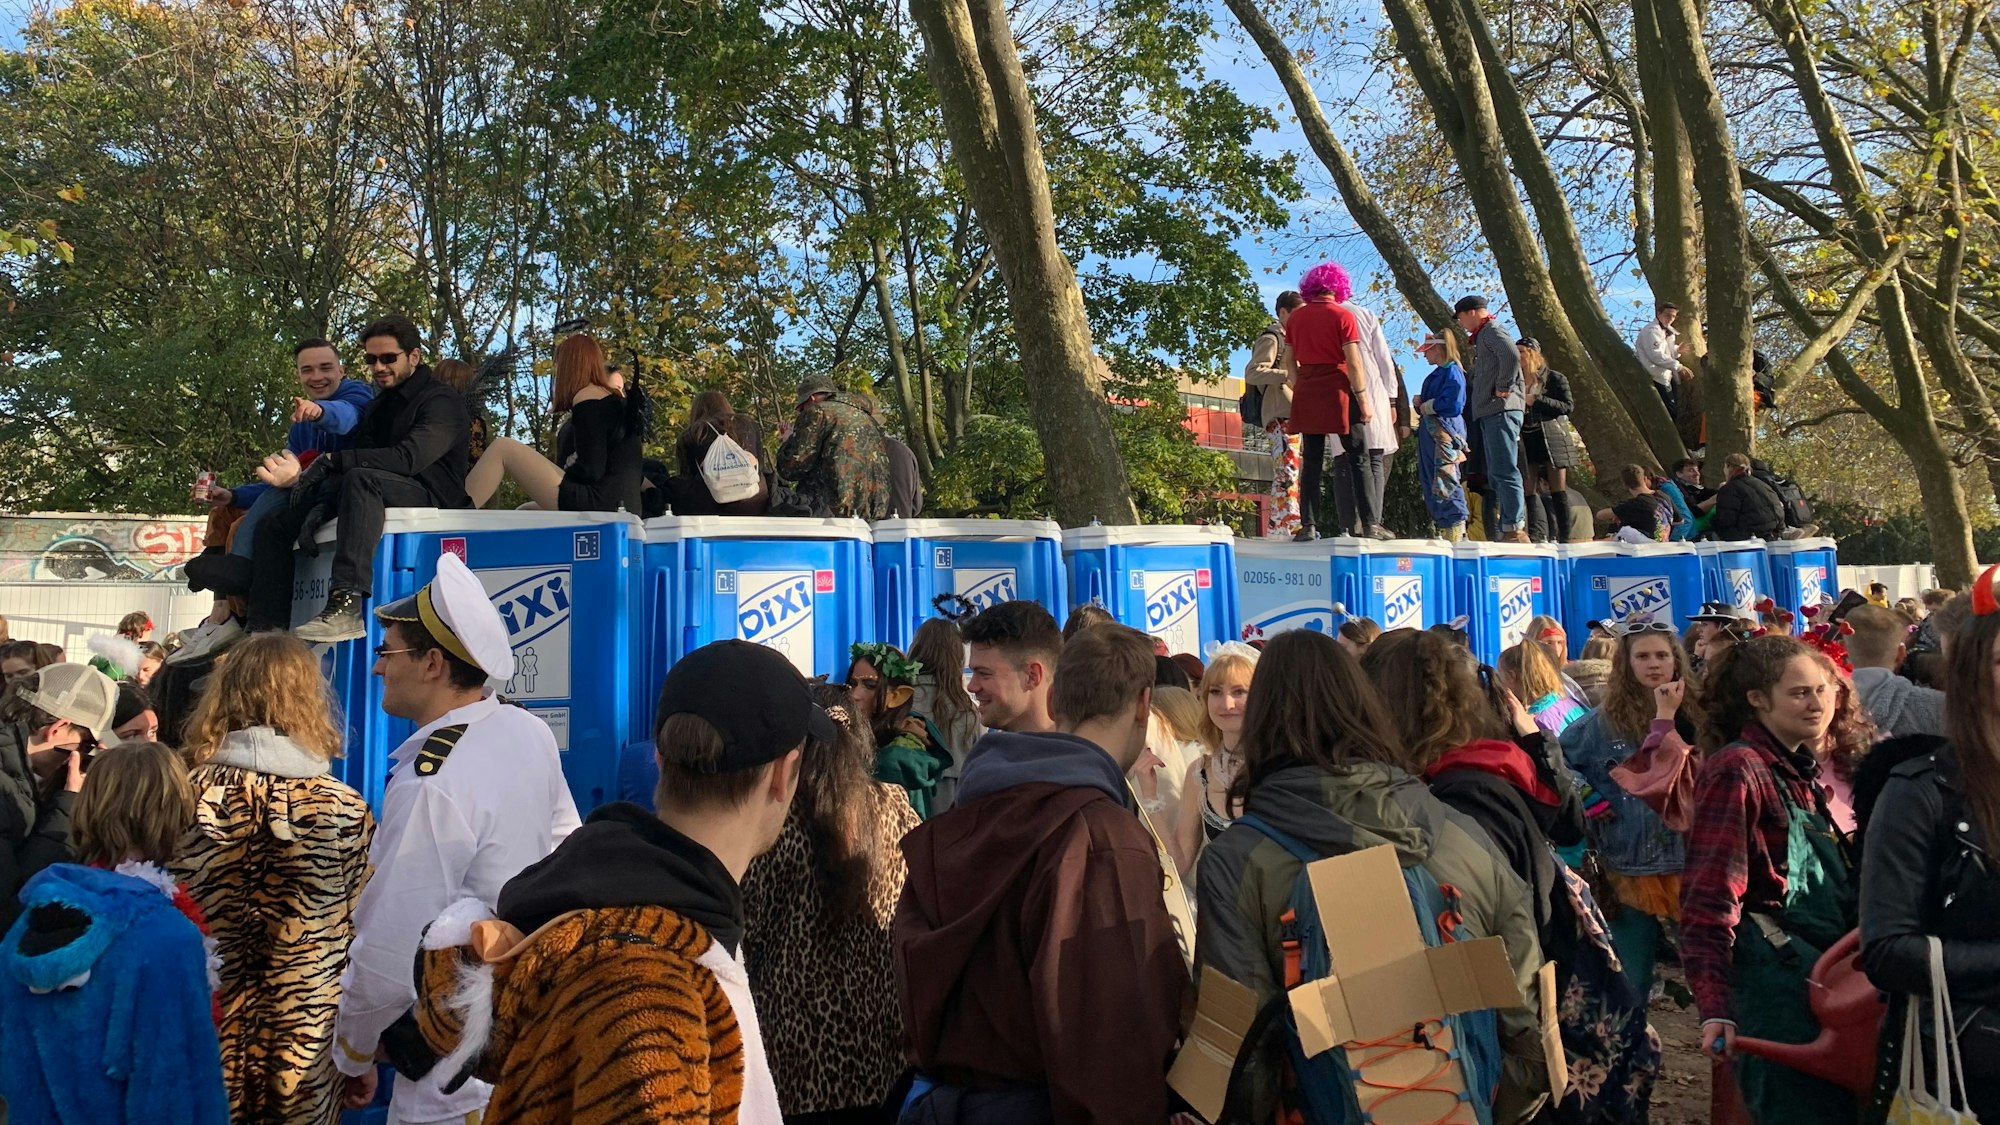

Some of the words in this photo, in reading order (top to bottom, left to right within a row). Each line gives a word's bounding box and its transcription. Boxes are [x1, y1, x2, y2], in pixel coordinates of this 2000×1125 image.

[310, 579, 324, 599] 981
[1243, 571, 1276, 584] 02056
[1285, 573, 1305, 586] 981
[1308, 574, 1322, 587] 00
[499, 576, 569, 636] iXi
